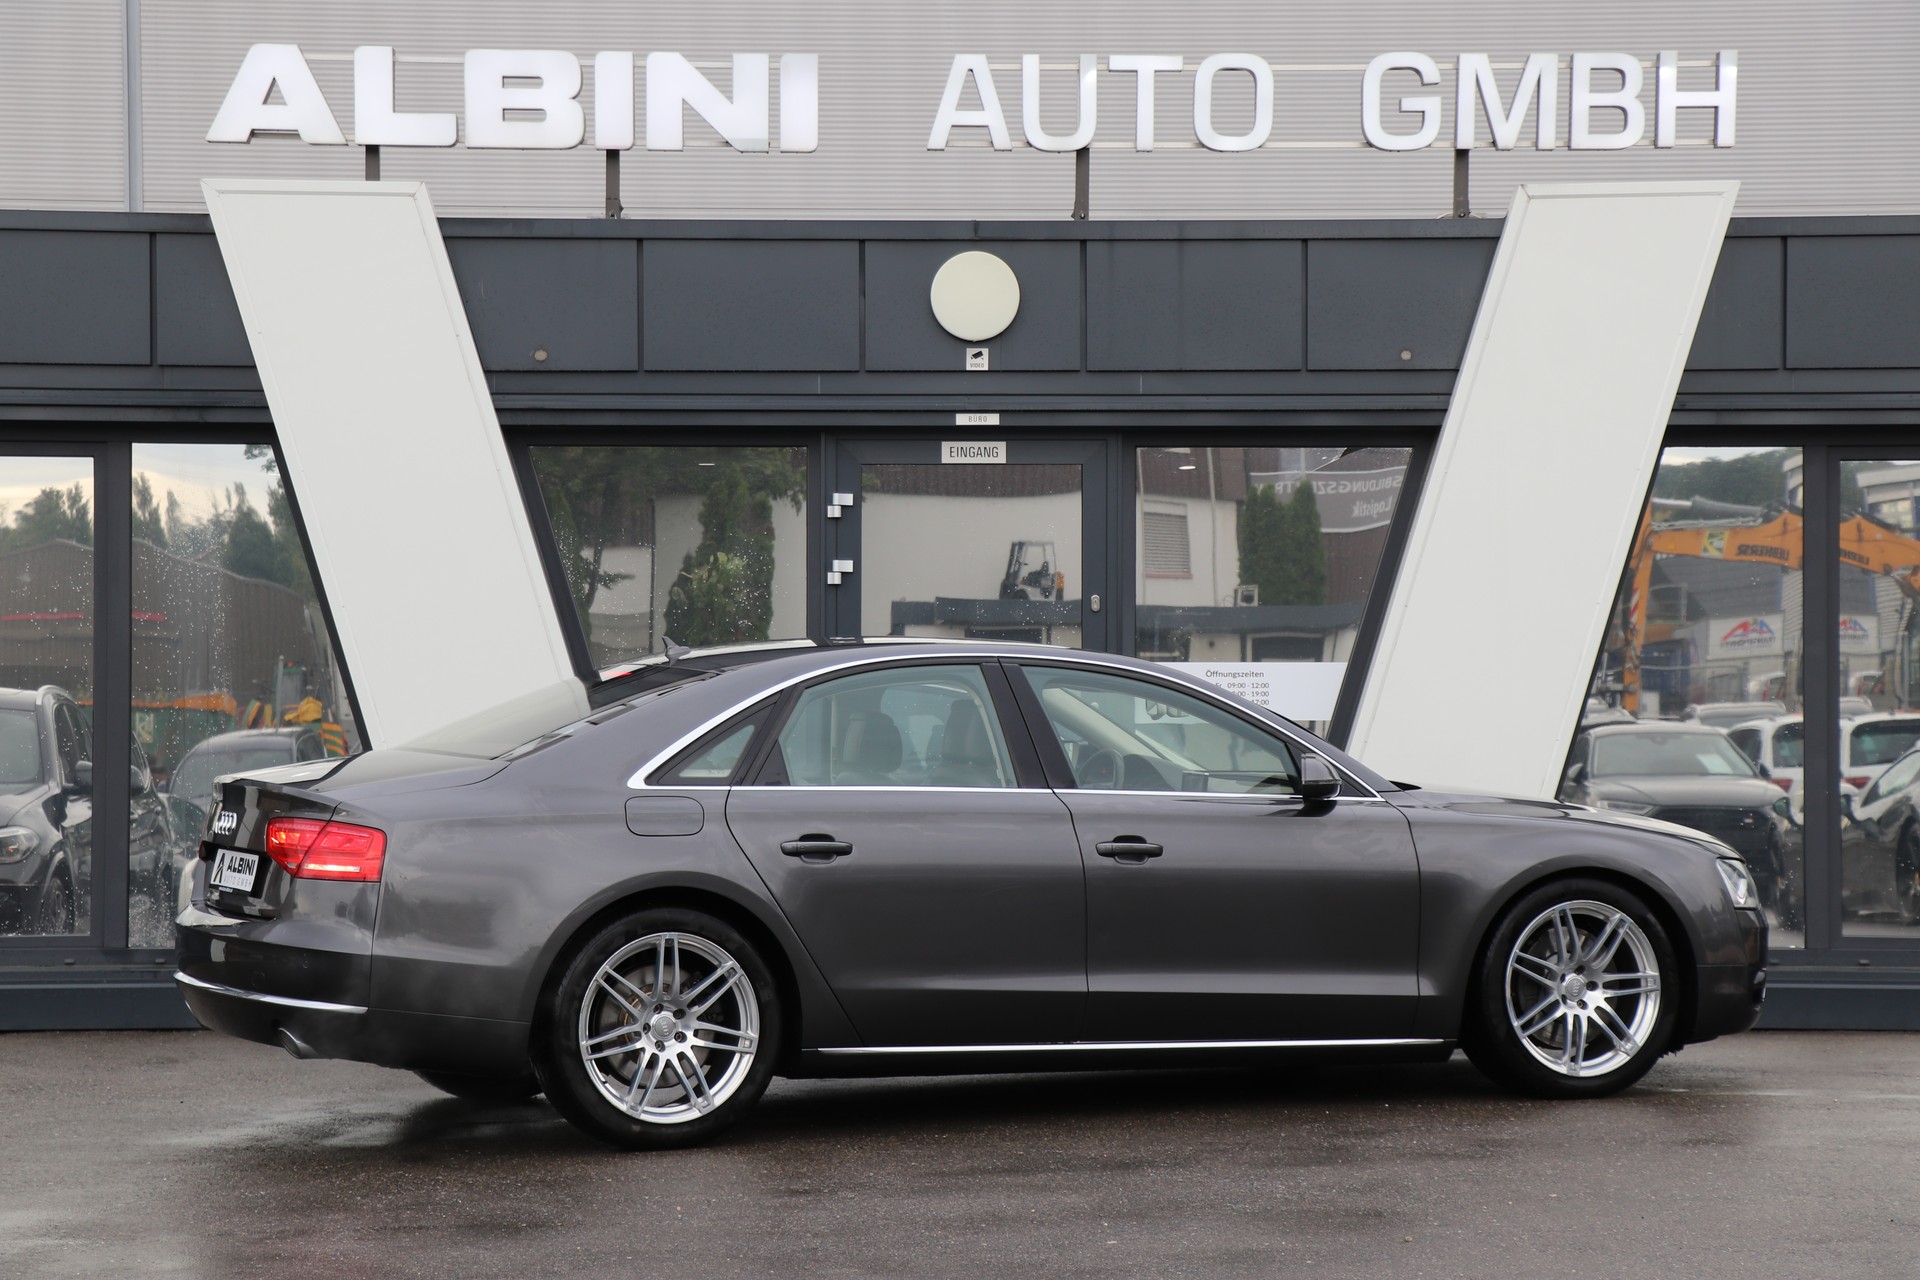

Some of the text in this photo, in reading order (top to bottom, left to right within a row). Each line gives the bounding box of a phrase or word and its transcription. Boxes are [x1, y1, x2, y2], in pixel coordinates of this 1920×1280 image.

[205, 43, 1739, 153] ALBINI AUTO GMBH
[968, 414, 988, 422] BÜRO
[949, 446, 999, 458] EINGANG
[1205, 670, 1264, 679] Öffnungszeiten
[226, 855, 256, 876] ALBINI
